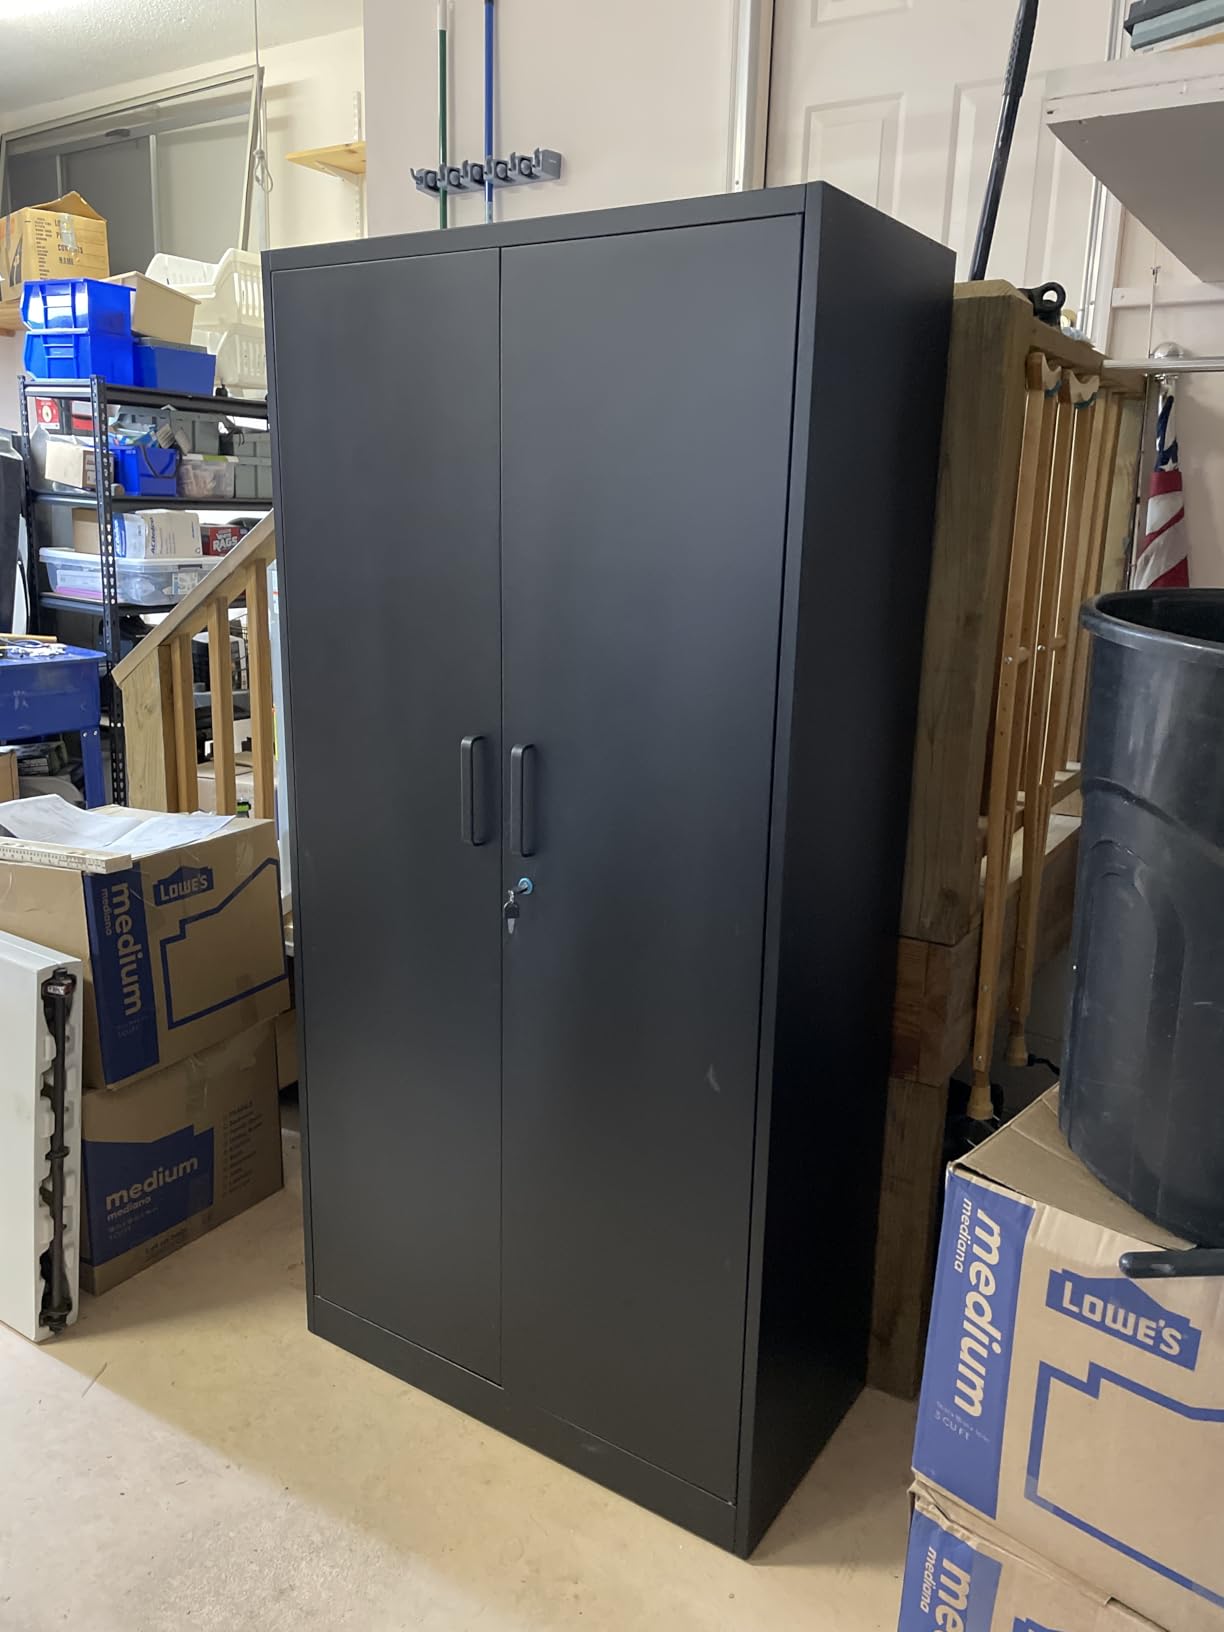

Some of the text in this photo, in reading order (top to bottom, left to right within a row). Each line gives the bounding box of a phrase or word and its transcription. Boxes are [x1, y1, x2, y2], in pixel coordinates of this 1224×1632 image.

[213, 536, 238, 552] RAGS
[100, 888, 112, 936] mediana
[159, 873, 208, 901] LOWE'S
[112, 881, 144, 1016] medium
[105, 1156, 200, 1210] medium
[106, 1196, 153, 1222] mediana
[953, 1197, 974, 1273] mediana
[953, 1208, 1003, 1418] medium
[1061, 1280, 1184, 1357] LOWE'S
[920, 1546, 937, 1614] mediana
